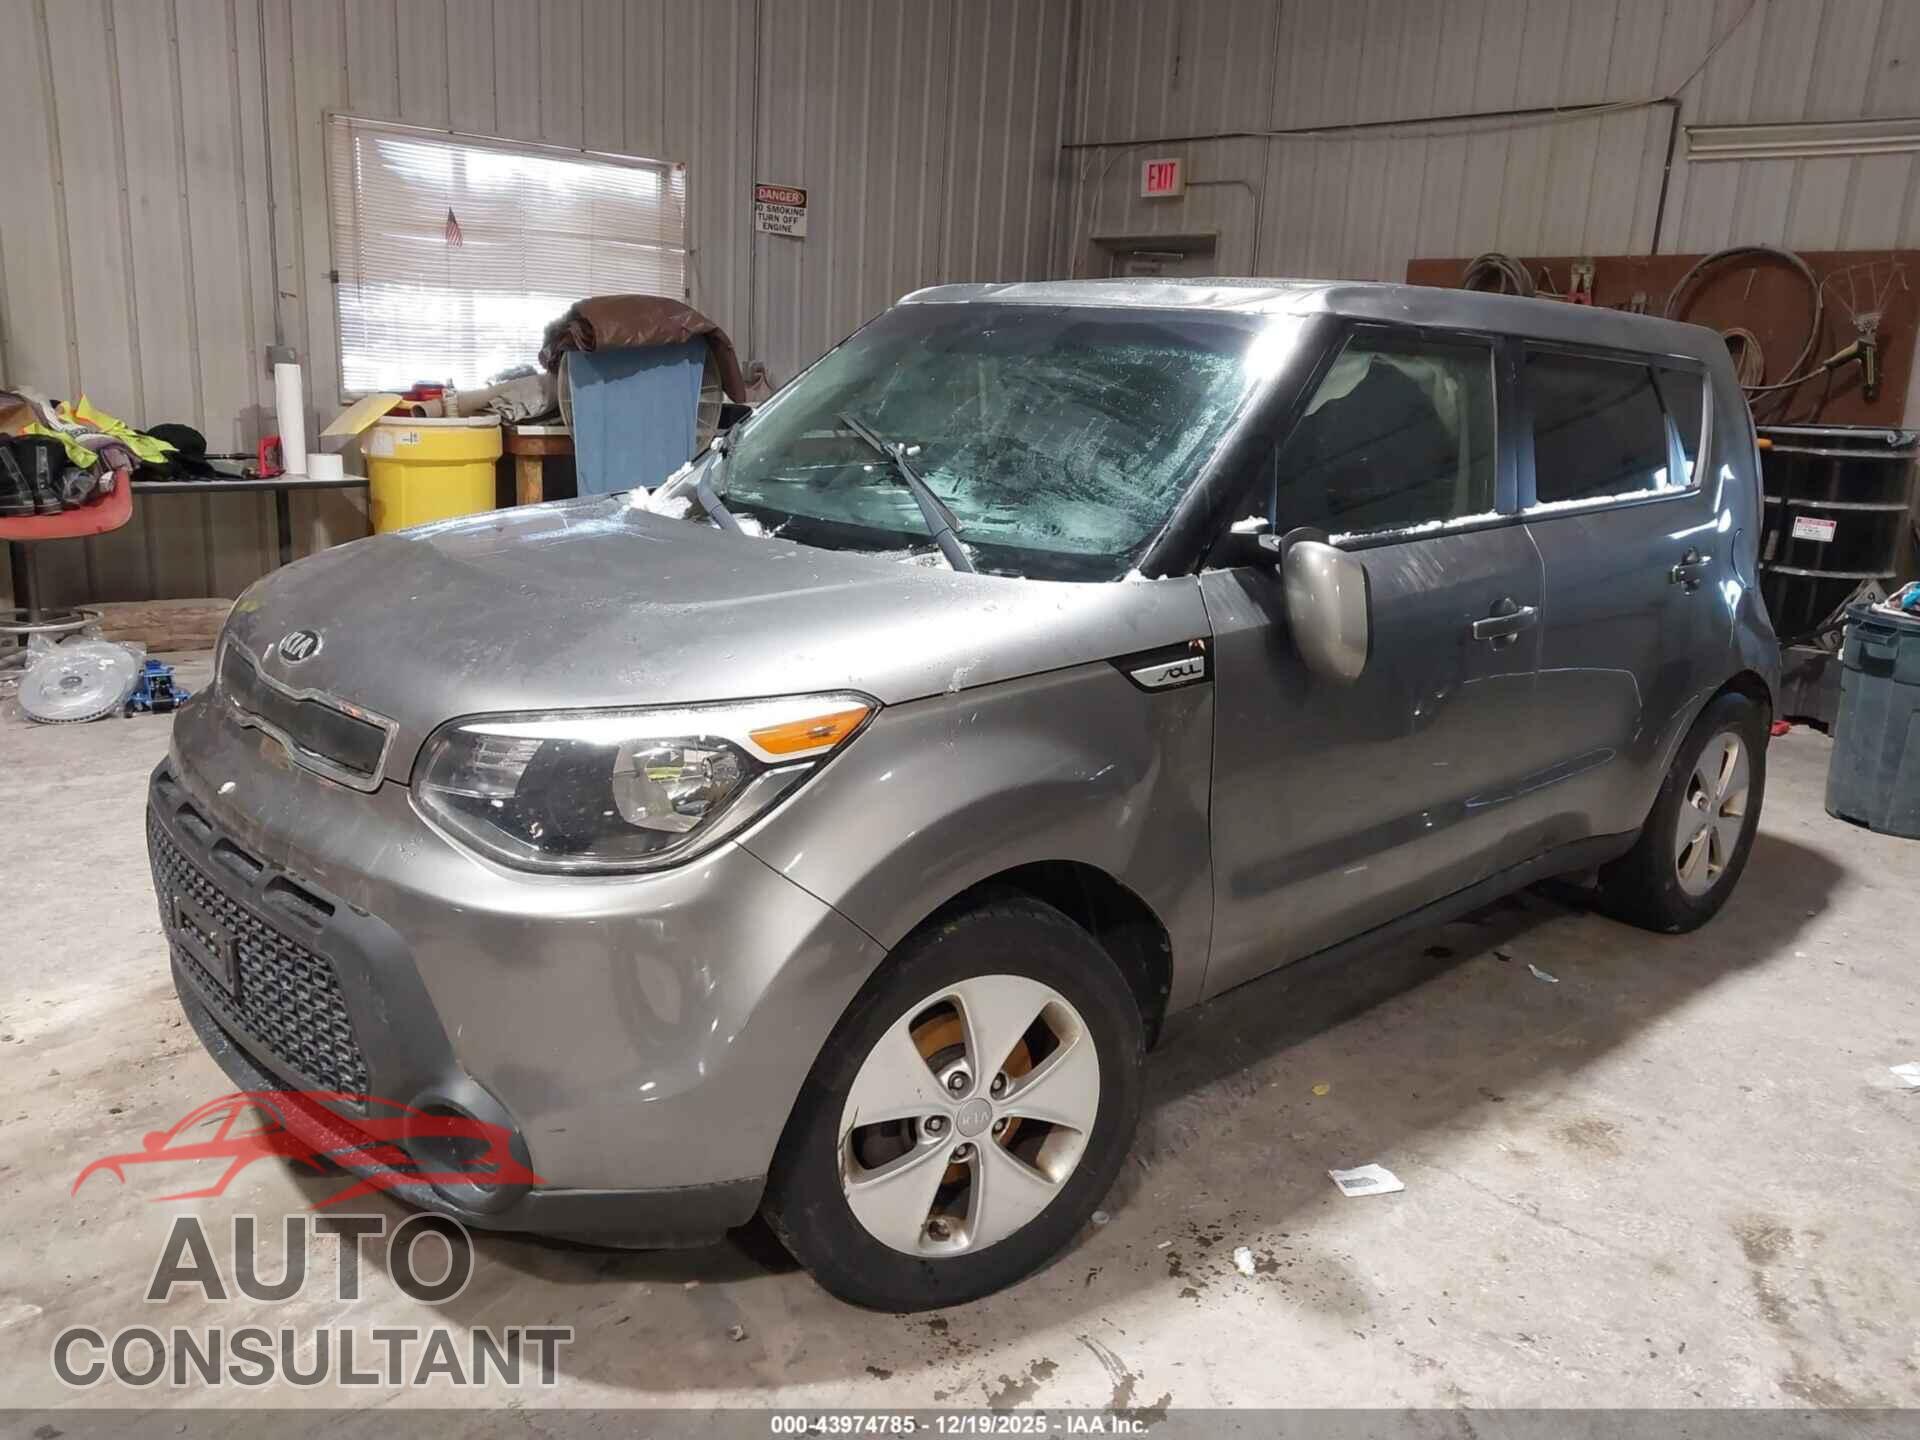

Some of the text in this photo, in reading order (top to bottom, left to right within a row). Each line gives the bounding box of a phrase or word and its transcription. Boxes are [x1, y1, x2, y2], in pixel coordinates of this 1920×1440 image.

[1148, 163, 1175, 192] EXIT
[759, 188, 800, 202] DANGER
[766, 205, 805, 216] SMOKING
[758, 213, 798, 224] TURN OFF
[763, 222, 792, 233] ENGINE
[284, 631, 313, 658] KIA
